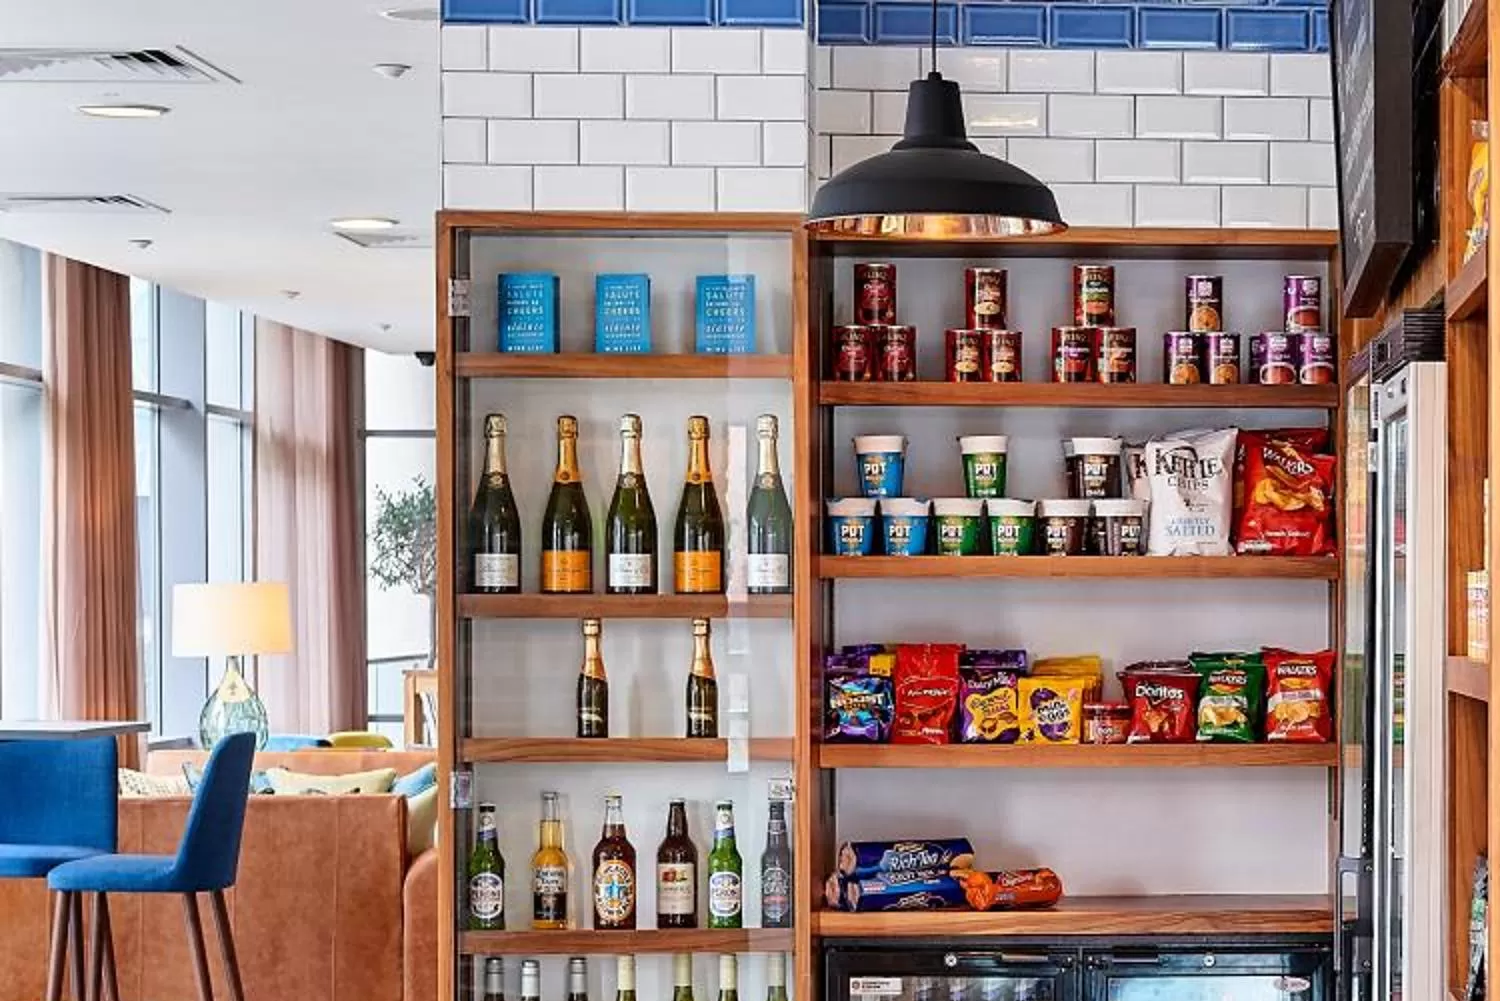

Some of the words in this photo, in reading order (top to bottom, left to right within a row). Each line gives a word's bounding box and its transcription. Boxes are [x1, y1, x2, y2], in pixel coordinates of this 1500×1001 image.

[1155, 446, 1222, 480] KETTLE
[1263, 447, 1315, 475] WALKERS
[864, 462, 886, 475] POT
[975, 464, 997, 475] POT
[1167, 477, 1209, 491] CHIPS
[841, 525, 865, 537] POT
[889, 525, 911, 537] POT
[941, 525, 964, 537] POT
[997, 525, 1021, 537] POT
[1165, 525, 1215, 537] SALTED
[1136, 684, 1184, 699] Doritos
[890, 853, 918, 870] Rich
